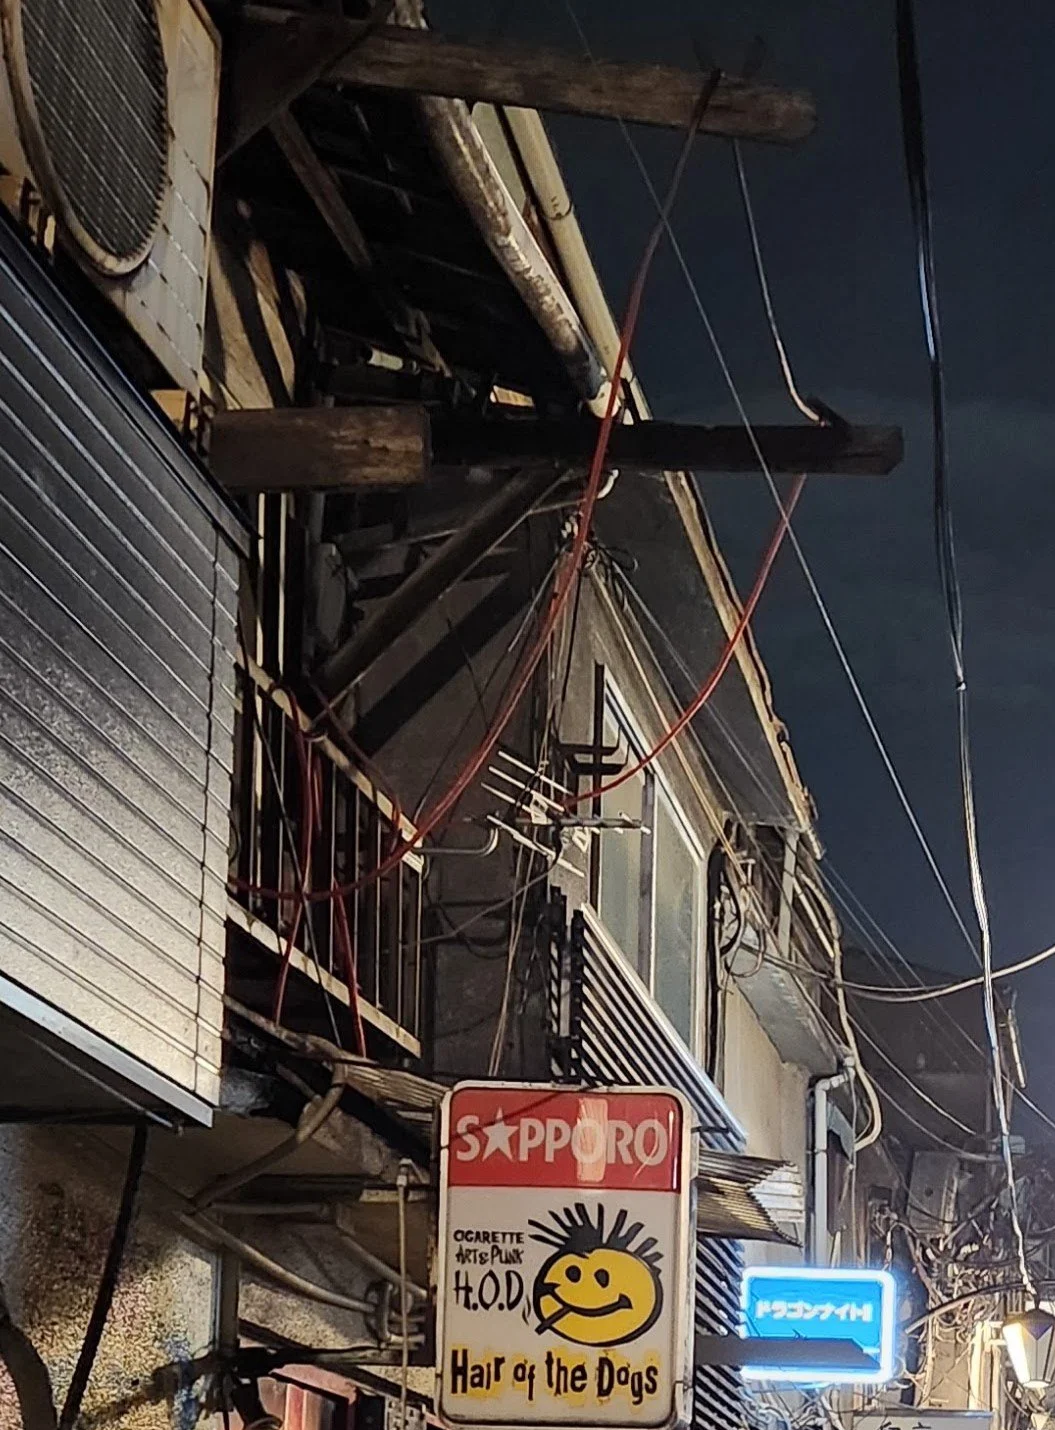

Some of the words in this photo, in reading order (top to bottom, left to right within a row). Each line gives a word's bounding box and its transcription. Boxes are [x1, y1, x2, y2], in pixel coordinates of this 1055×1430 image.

[451, 1349, 505, 1395] Hair
[514, 1359, 537, 1400] of
[545, 1350, 587, 1396] the
[596, 1355, 659, 1406] Dogs
